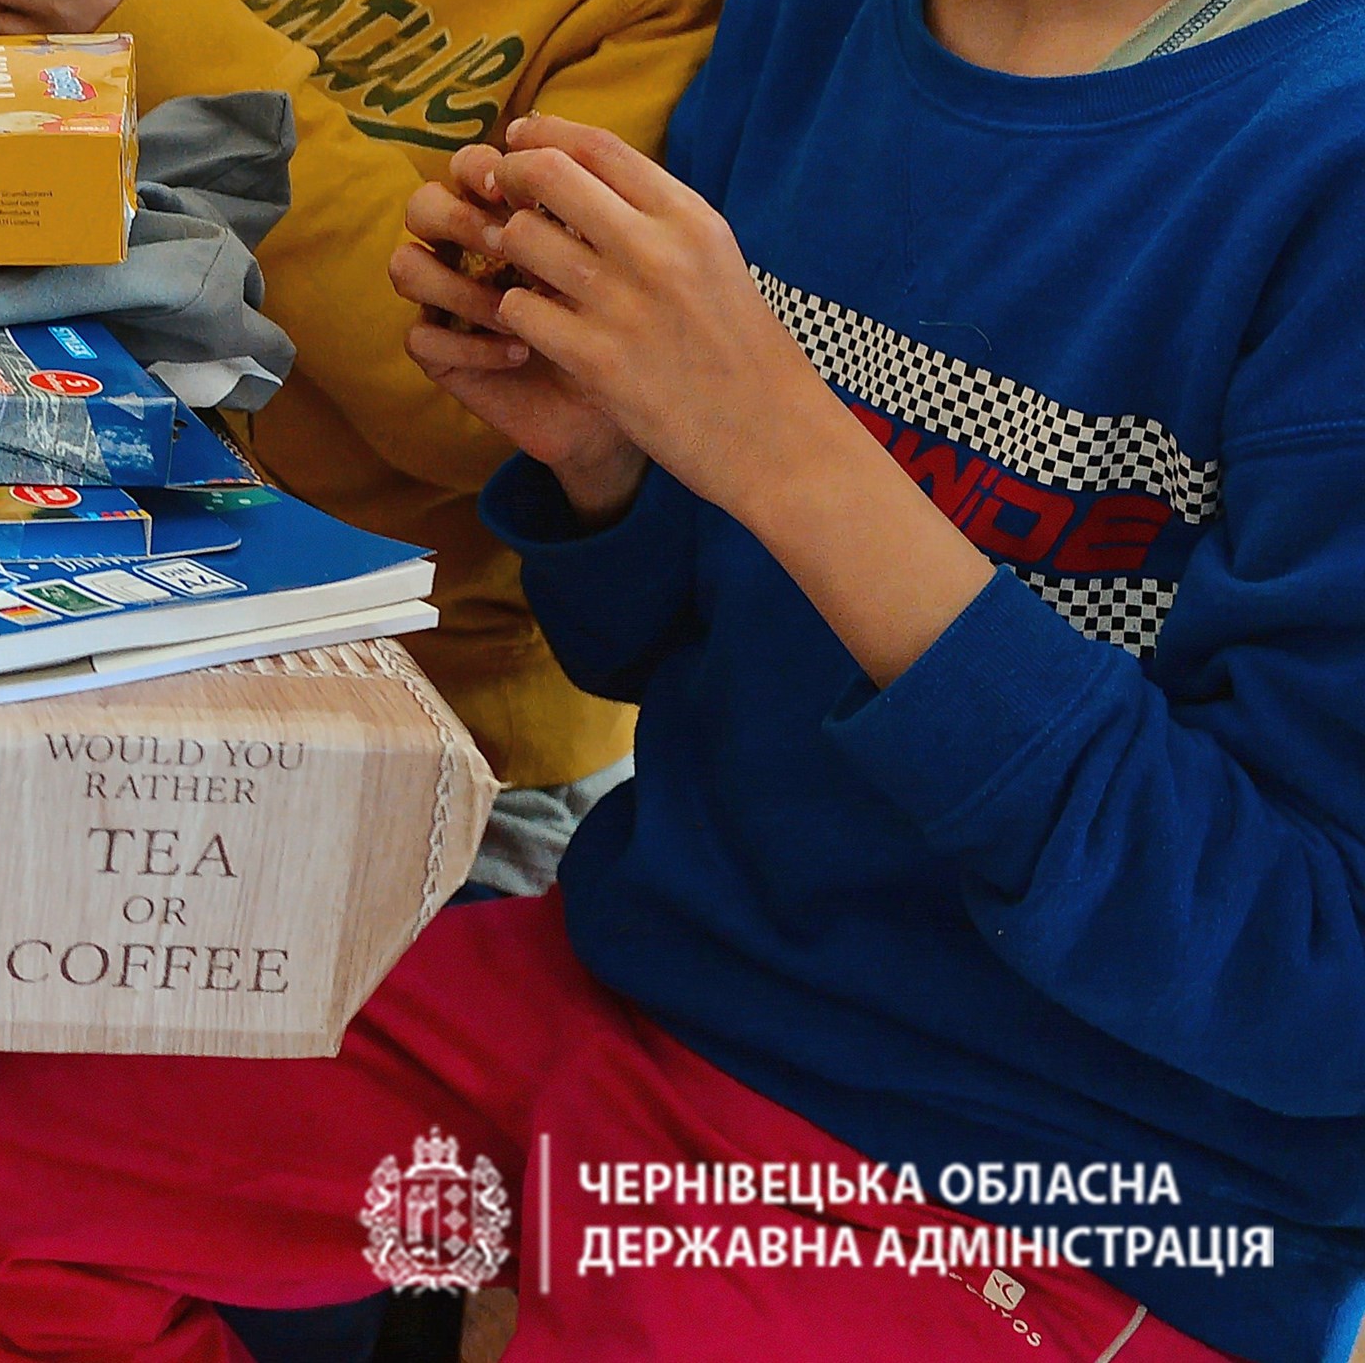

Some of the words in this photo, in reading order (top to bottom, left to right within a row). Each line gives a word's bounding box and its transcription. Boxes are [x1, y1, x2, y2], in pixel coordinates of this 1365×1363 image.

[178, 574, 222, 590] A4
[46, 733, 205, 771] WOULD
[222, 739, 305, 771] YOU
[86, 771, 256, 805] RATHER
[87, 827, 237, 878] TEA
[123, 894, 186, 927] OR
[5, 939, 291, 995] COFFEE
